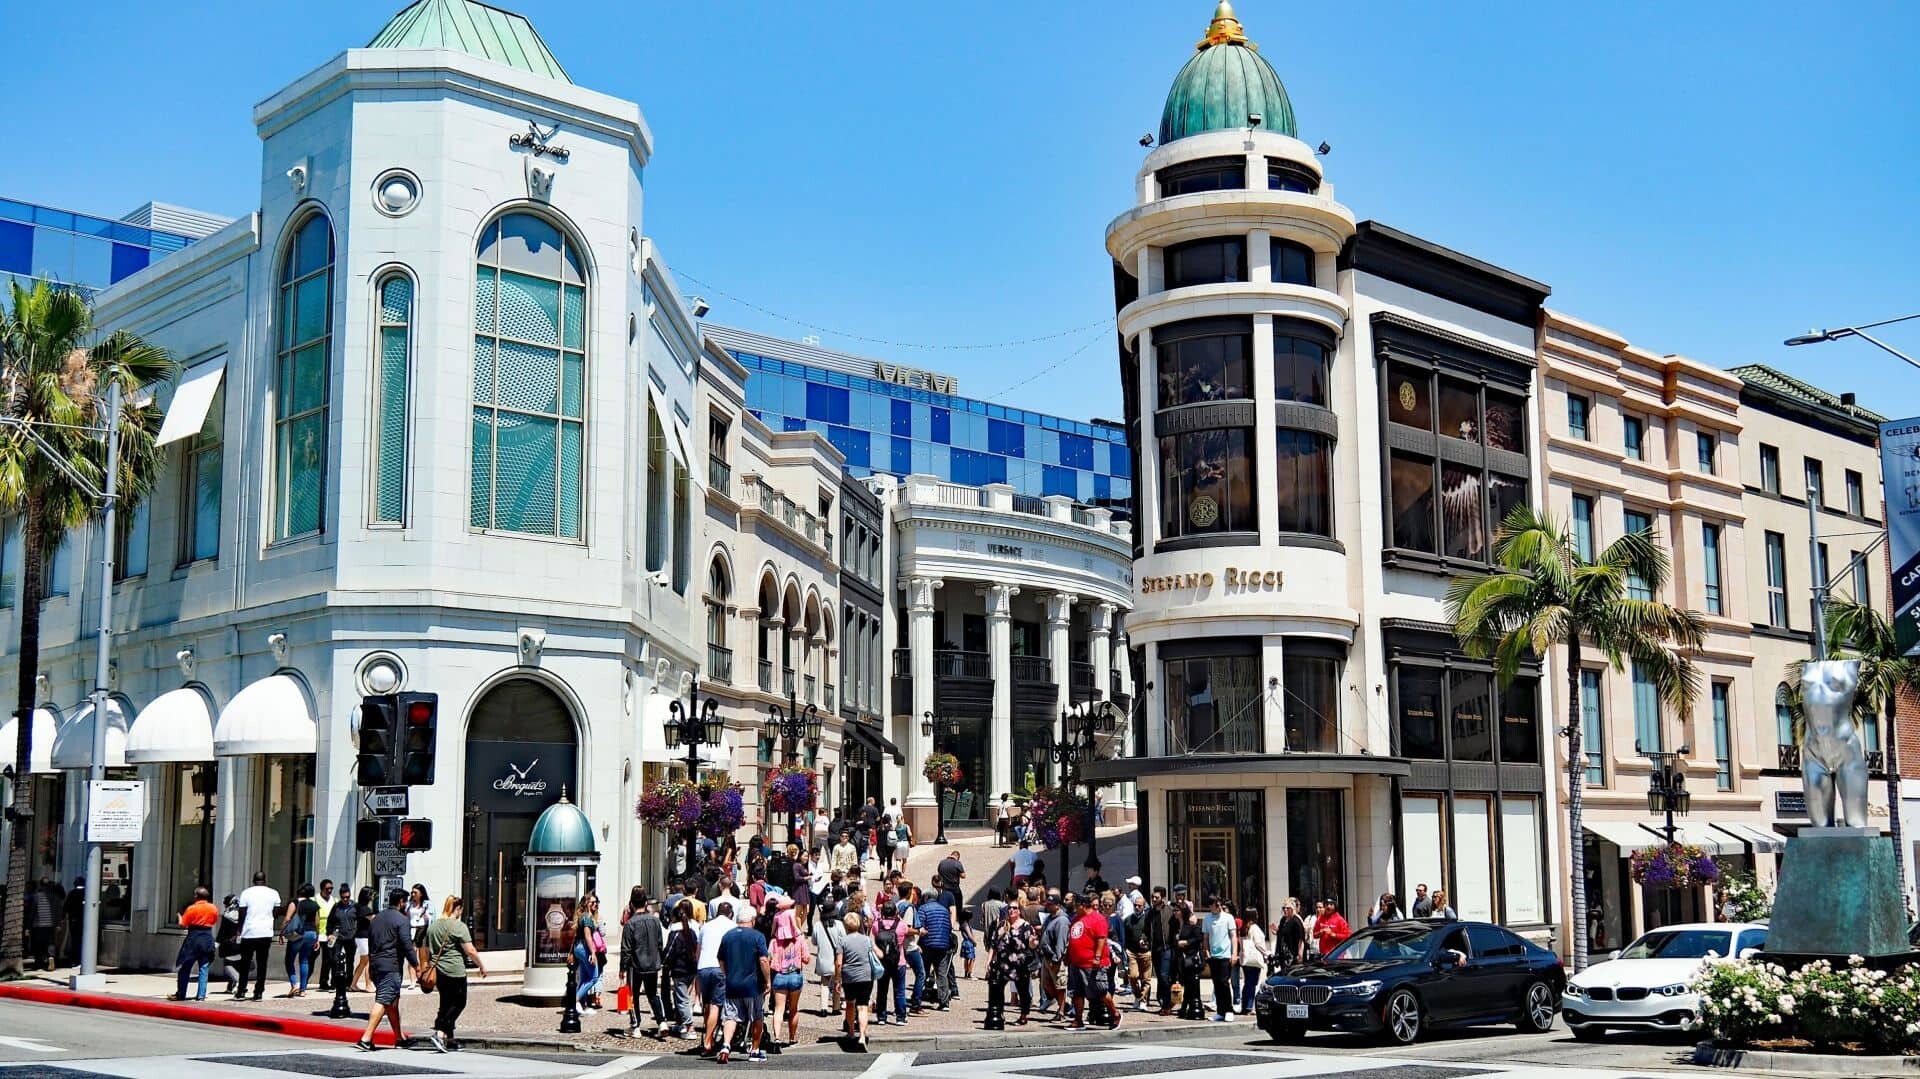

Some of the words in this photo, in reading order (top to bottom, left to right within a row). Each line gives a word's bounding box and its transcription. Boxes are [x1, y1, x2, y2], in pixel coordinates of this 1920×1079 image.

[509, 133, 570, 157] Breguet
[878, 361, 953, 396] MGM
[987, 543, 1023, 557] VERSACE
[1142, 572, 1214, 594] STEFANO
[1225, 567, 1284, 586] RICCI
[493, 775, 547, 796] Breguet
[378, 796, 389, 807] ONE
[391, 795, 403, 806] WAY
[1188, 804, 1215, 812] STEFANO
[1216, 804, 1235, 812] RICCI
[376, 860, 387, 872] OK
